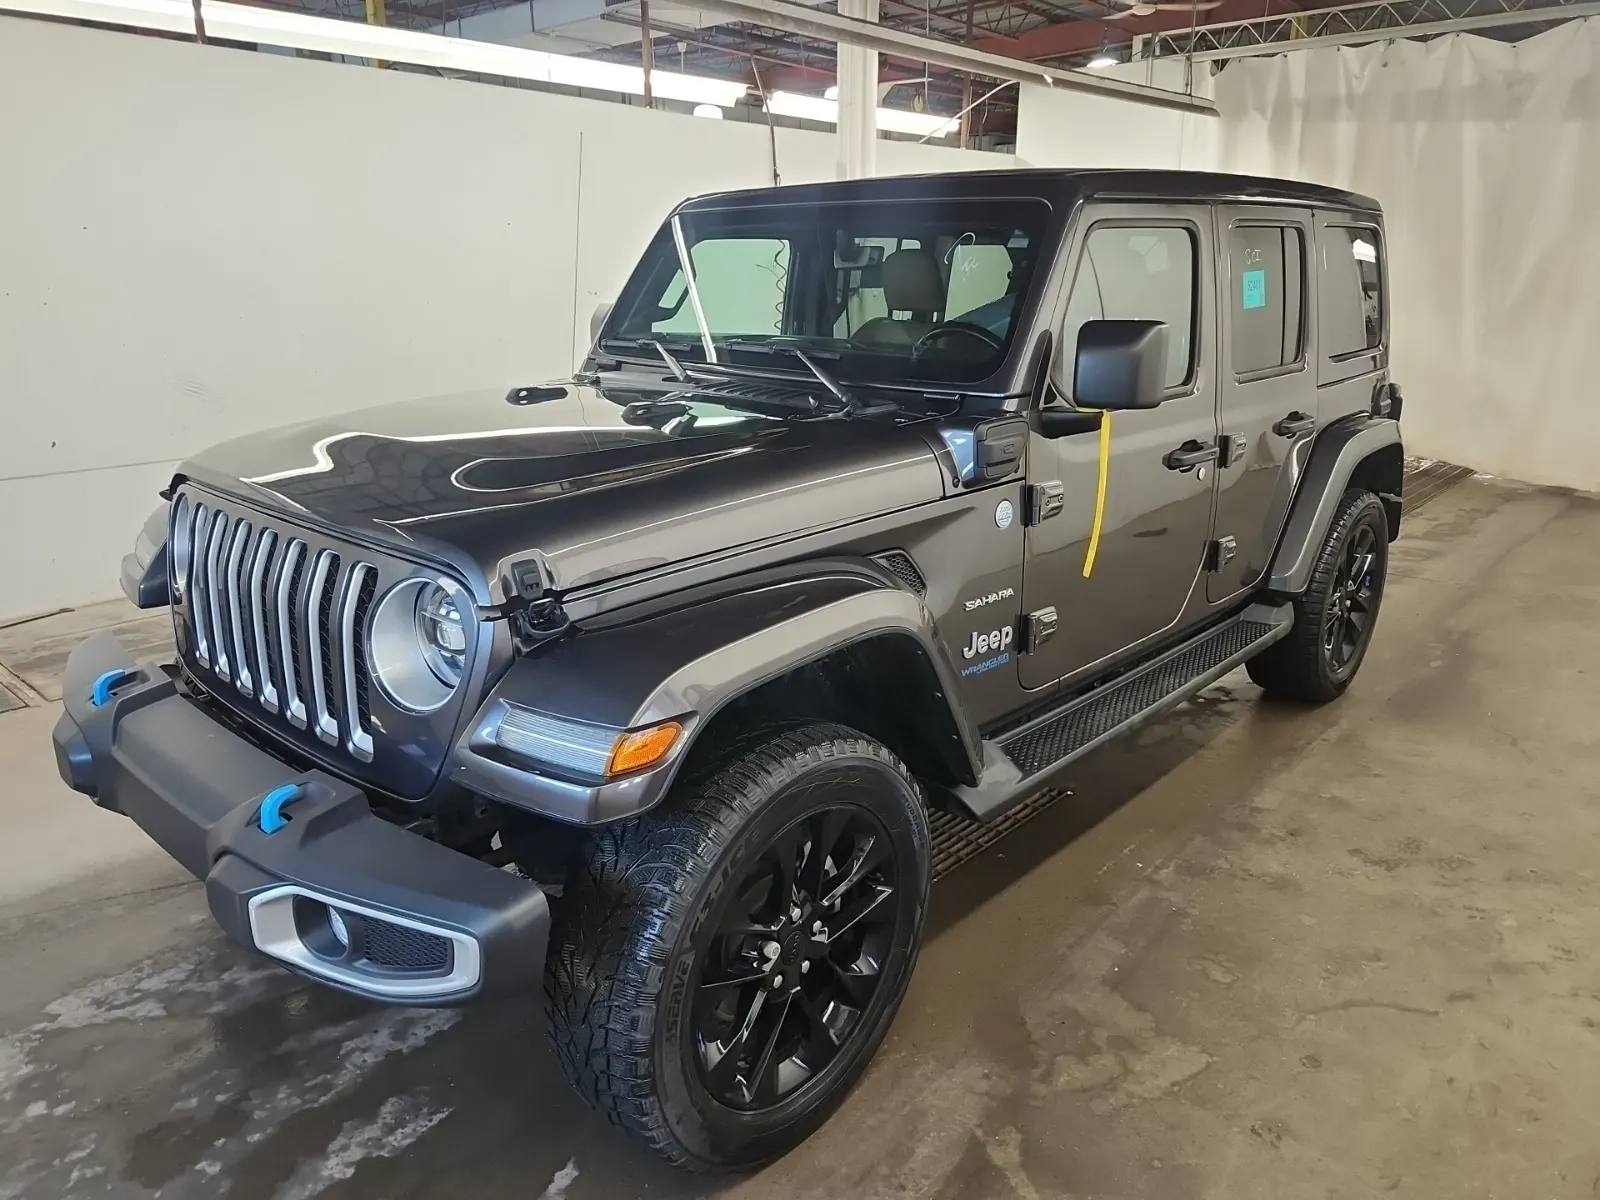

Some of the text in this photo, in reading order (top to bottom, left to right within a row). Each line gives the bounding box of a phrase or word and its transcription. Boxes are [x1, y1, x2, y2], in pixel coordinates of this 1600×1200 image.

[964, 587, 1014, 611] SAHARA
[962, 625, 1013, 659] Jeep
[961, 652, 1009, 677] WRANGLER
